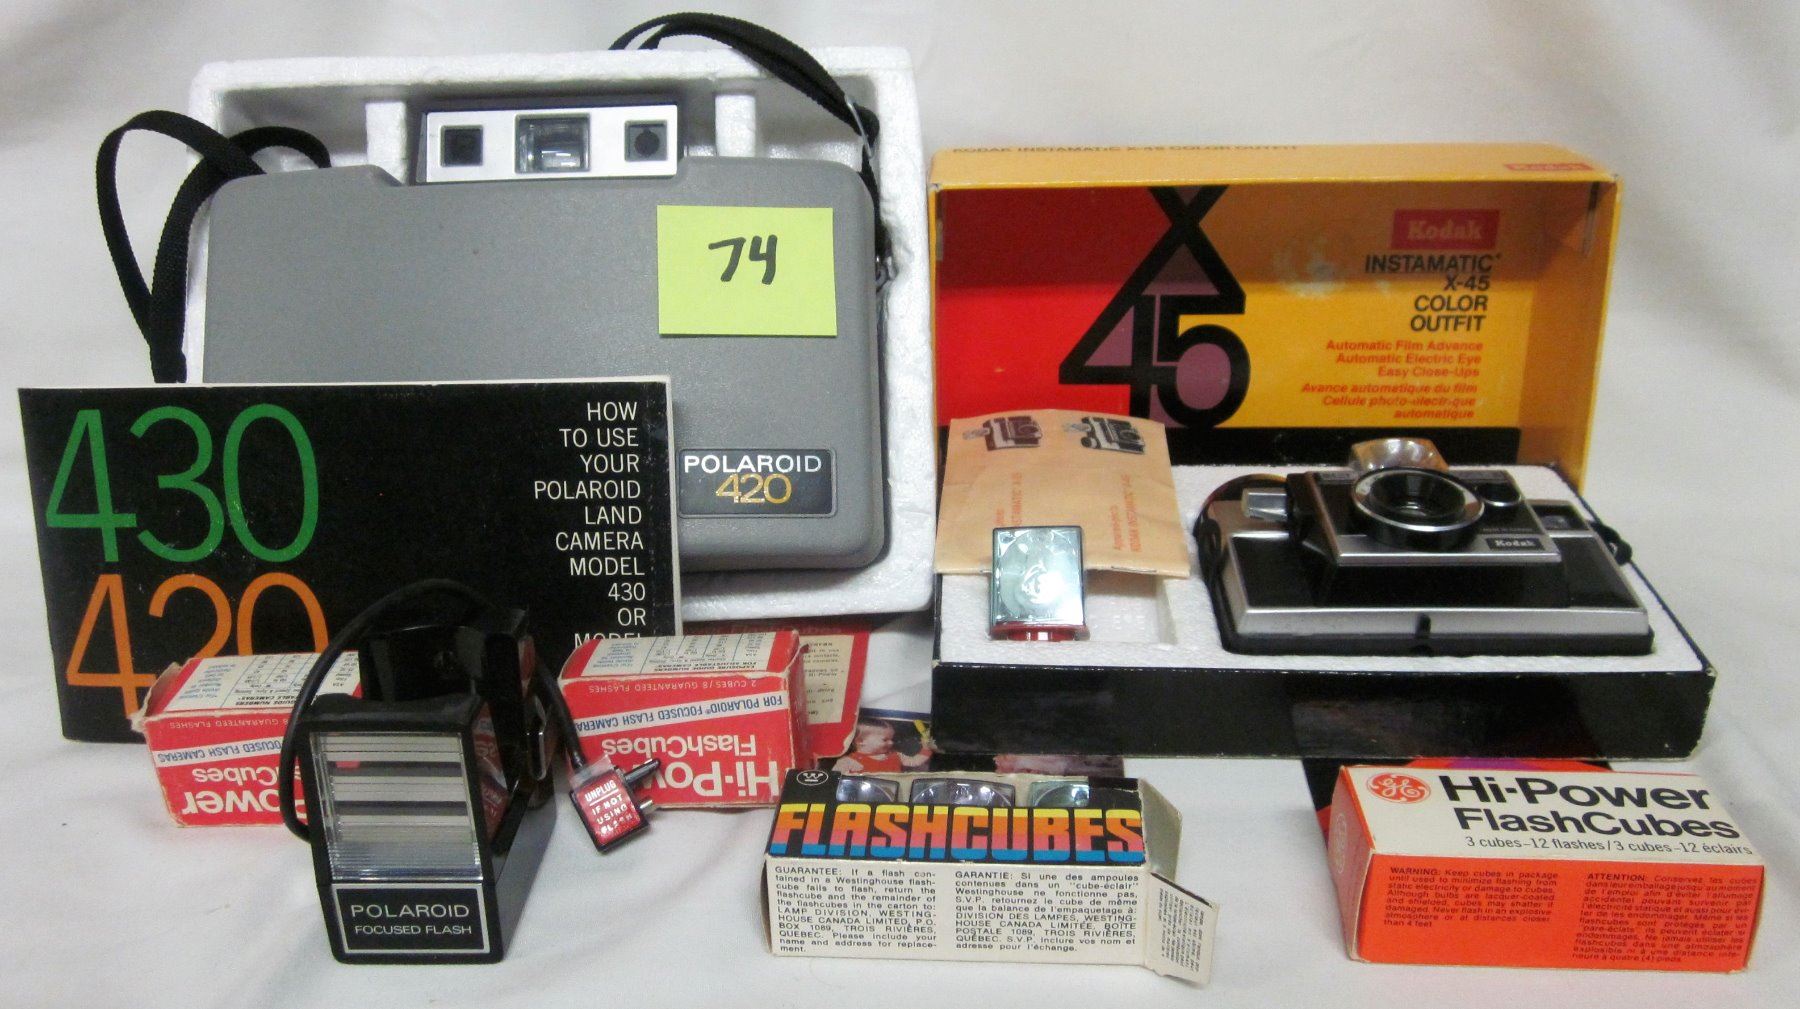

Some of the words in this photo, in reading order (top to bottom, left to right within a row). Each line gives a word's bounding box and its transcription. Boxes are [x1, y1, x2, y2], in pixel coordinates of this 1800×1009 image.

[1407, 220, 1485, 240] Kodak
[708, 234, 778, 285] 74
[1444, 276, 1490, 291] X-45
[1414, 296, 1488, 311] COLOR
[1410, 315, 1486, 332] OUTFIT
[1326, 340, 1391, 350] Automatic
[1396, 340, 1422, 350] Film
[1428, 341, 1483, 350] Advance
[1336, 353, 1400, 363] Automatic
[1406, 353, 1453, 363] Electric
[1459, 354, 1481, 365] Eye
[1378, 367, 1408, 377] Easy
[1413, 367, 1479, 377] Close-Ups
[588, 402, 637, 421] HOW
[559, 429, 587, 447] TO
[597, 428, 639, 446] USE
[580, 454, 639, 473] YOUR
[684, 455, 822, 473] POLAROID
[46, 404, 319, 562] 430
[534, 480, 640, 499] POLAROID
[716, 474, 792, 504] 420
[585, 506, 641, 524] LAND
[555, 532, 643, 550] CAMERA
[570, 557, 645, 576] MODEL
[608, 583, 646, 601] 430
[617, 608, 646, 626] OR
[589, 684, 630, 693] FLASHES
[633, 681, 697, 692] GUARANTEED
[763, 695, 782, 707] FOR
[622, 713, 653, 726] FLASH
[658, 706, 703, 720] FOCUSED
[576, 717, 618, 733] CAMERA
[207, 747, 240, 756] FLASH
[244, 741, 281, 753] OCUSED
[602, 734, 756, 759] FlashCubes
[158, 751, 206, 762] CAMERAS
[585, 780, 617, 801] UNPLUG
[1438, 775, 1709, 810] Hi-Power
[592, 806, 600, 815] IF
[604, 794, 622, 809] NOT
[597, 804, 627, 824] USING
[1453, 807, 1741, 839] FlashCubes
[768, 803, 1145, 863] FLASHCUBES
[1466, 836, 1474, 846] 3
[1702, 842, 1753, 855] éclairs
[775, 867, 842, 876] GUARANTEE:
[882, 869, 905, 877] flash
[955, 872, 1013, 880] GARANTIE:
[776, 875, 805, 883] tained
[836, 877, 904, 886] Westinghouse
[776, 883, 799, 891] cube
[852, 885, 877, 894] flash,
[777, 891, 822, 900] flashcube
[351, 904, 469, 918] POLAROID
[797, 901, 848, 909] flashcubes
[815, 909, 872, 917] DIVISION,
[779, 915, 813, 923] HOUSE
[866, 918, 911, 926] LIMITED,
[355, 926, 421, 935] FOCUSED
[426, 926, 472, 935] FLASH
